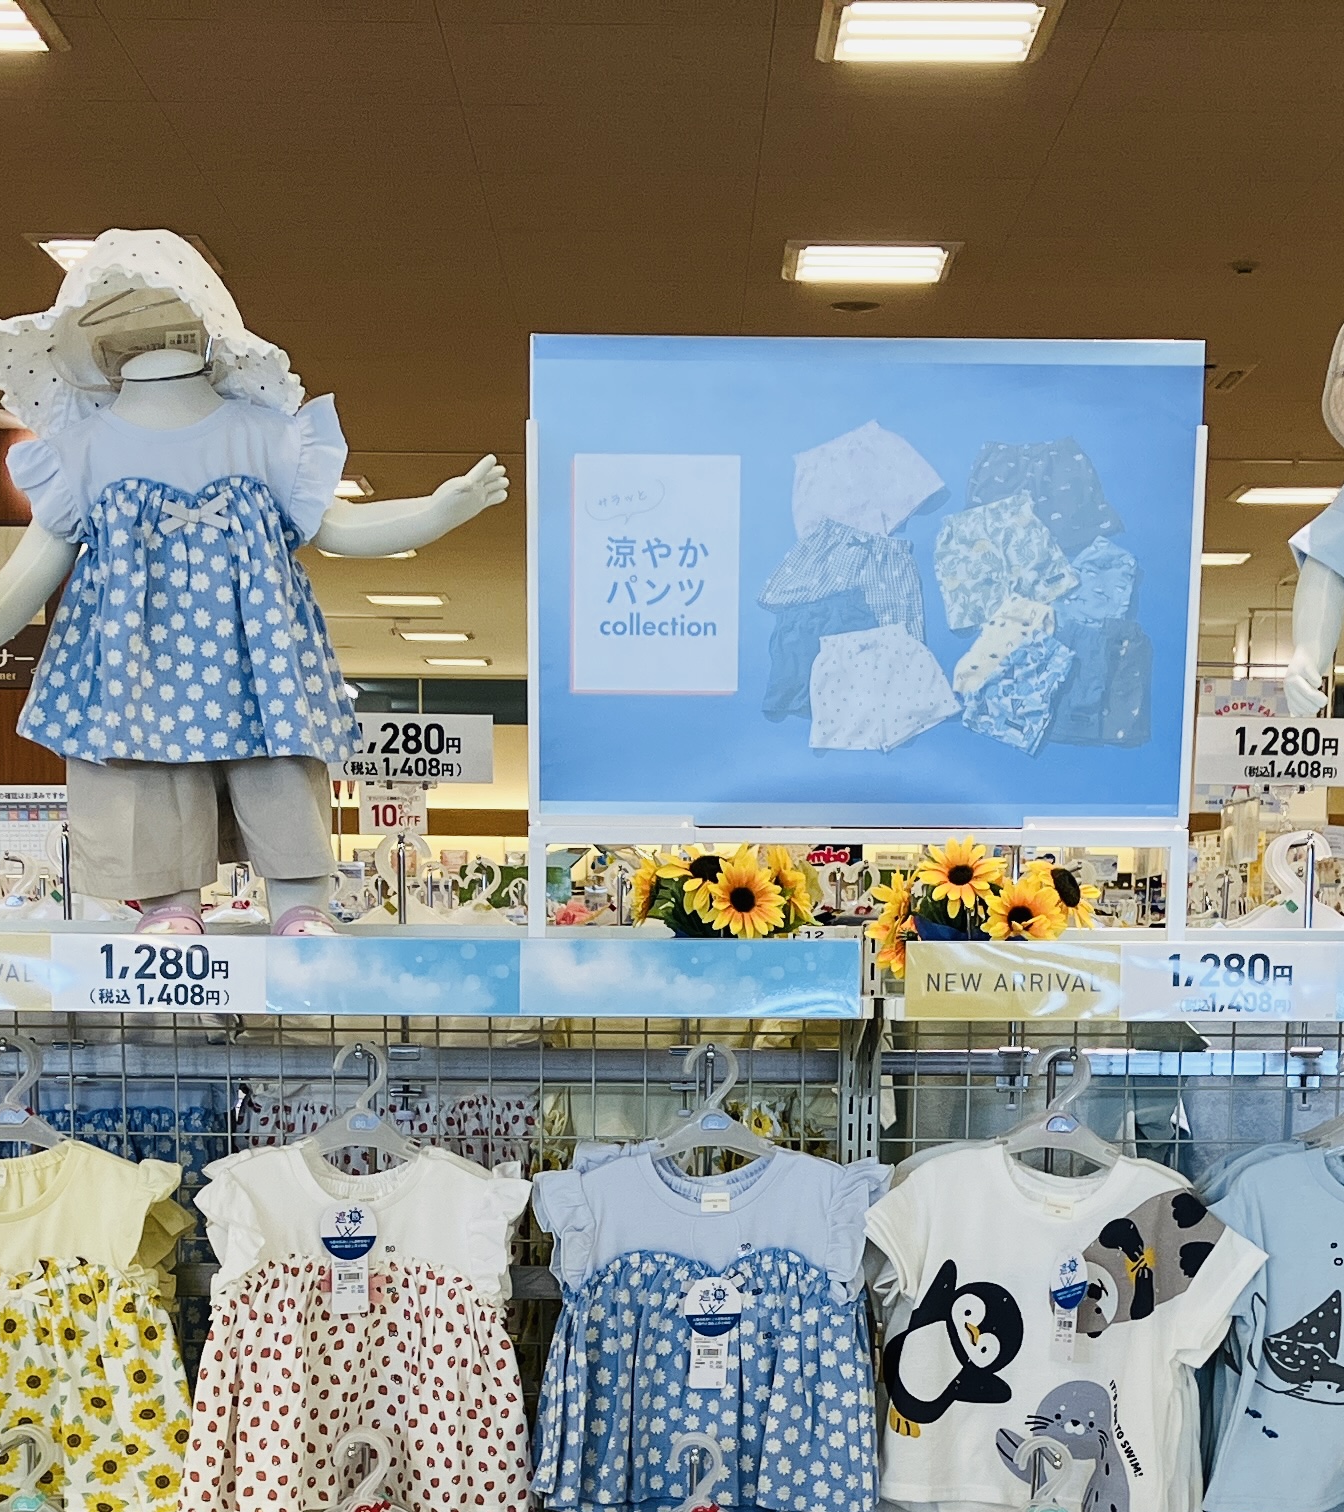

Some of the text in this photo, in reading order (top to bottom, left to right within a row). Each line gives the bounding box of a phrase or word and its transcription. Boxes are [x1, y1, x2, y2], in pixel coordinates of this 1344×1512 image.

[606, 536, 709, 568] 涼やか
[606, 575, 705, 606] パンツ
[599, 612, 717, 636] collection
[1235, 727, 1338, 756] 1,280円
[100, 944, 229, 980] 1,280円
[1168, 953, 1293, 988] 1,280円
[926, 972, 1102, 993] NEW ARRIVAL
[1121, 1439, 1144, 1479] SWIM!
